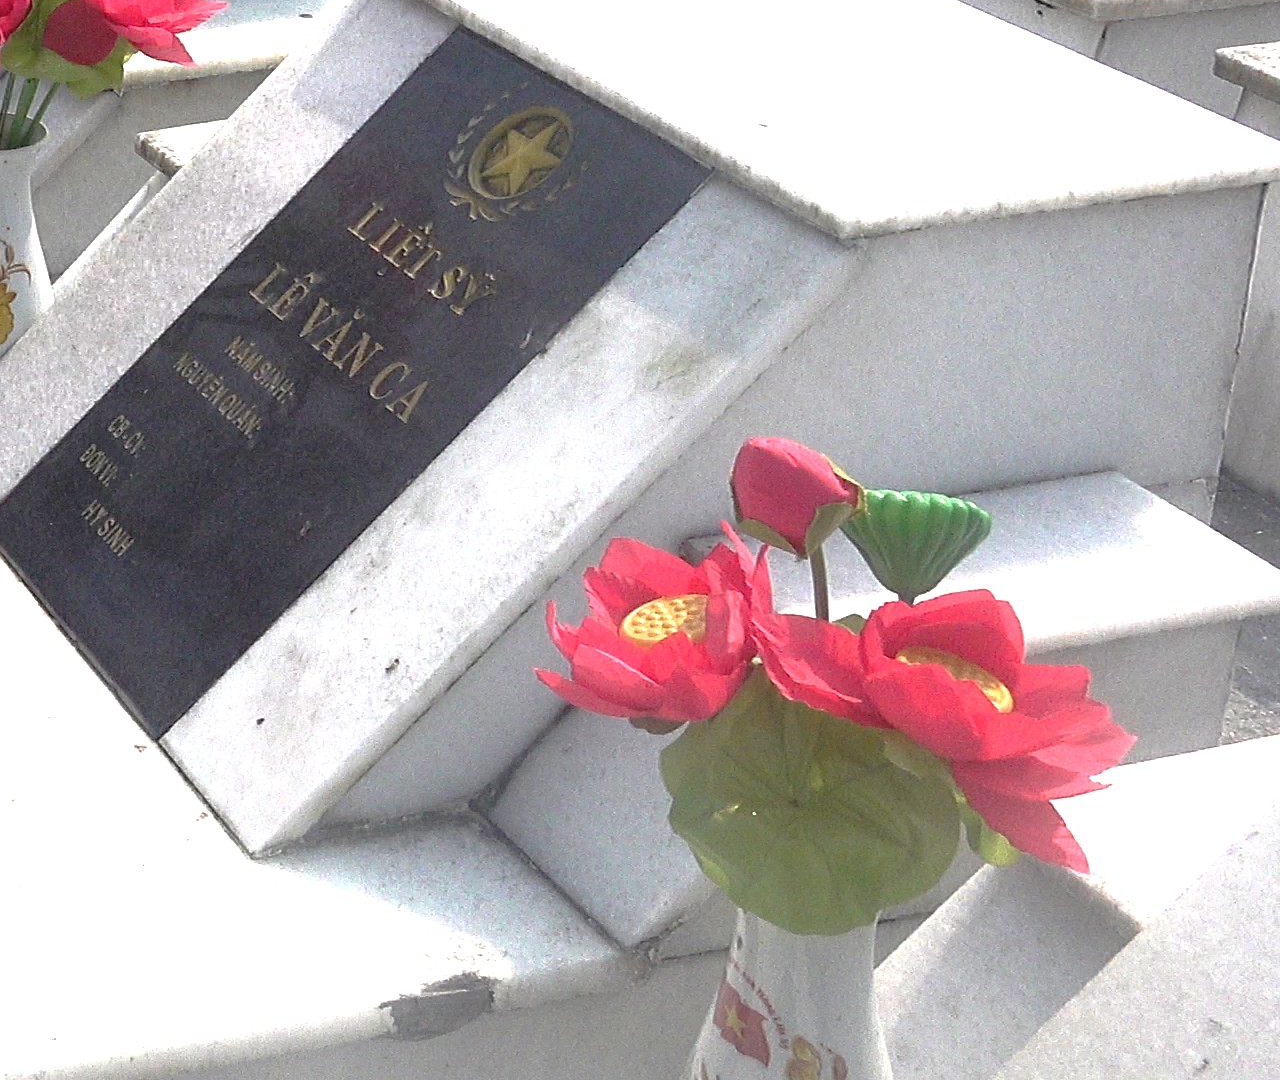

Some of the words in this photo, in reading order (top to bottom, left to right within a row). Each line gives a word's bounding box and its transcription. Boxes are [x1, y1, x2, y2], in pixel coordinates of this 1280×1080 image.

[347, 201, 440, 279] LIỆT
[427, 266, 497, 316] SỸ
[172, 351, 230, 406] NGUYÊN
[217, 393, 263, 441] QUÁN:
[224, 335, 265, 375] NĂM
[252, 361, 295, 405] SINH:
[299, 296, 384, 378] VĂN
[369, 361, 428, 424] CA
[80, 499, 108, 527] HY
[96, 517, 136, 558] SINH
